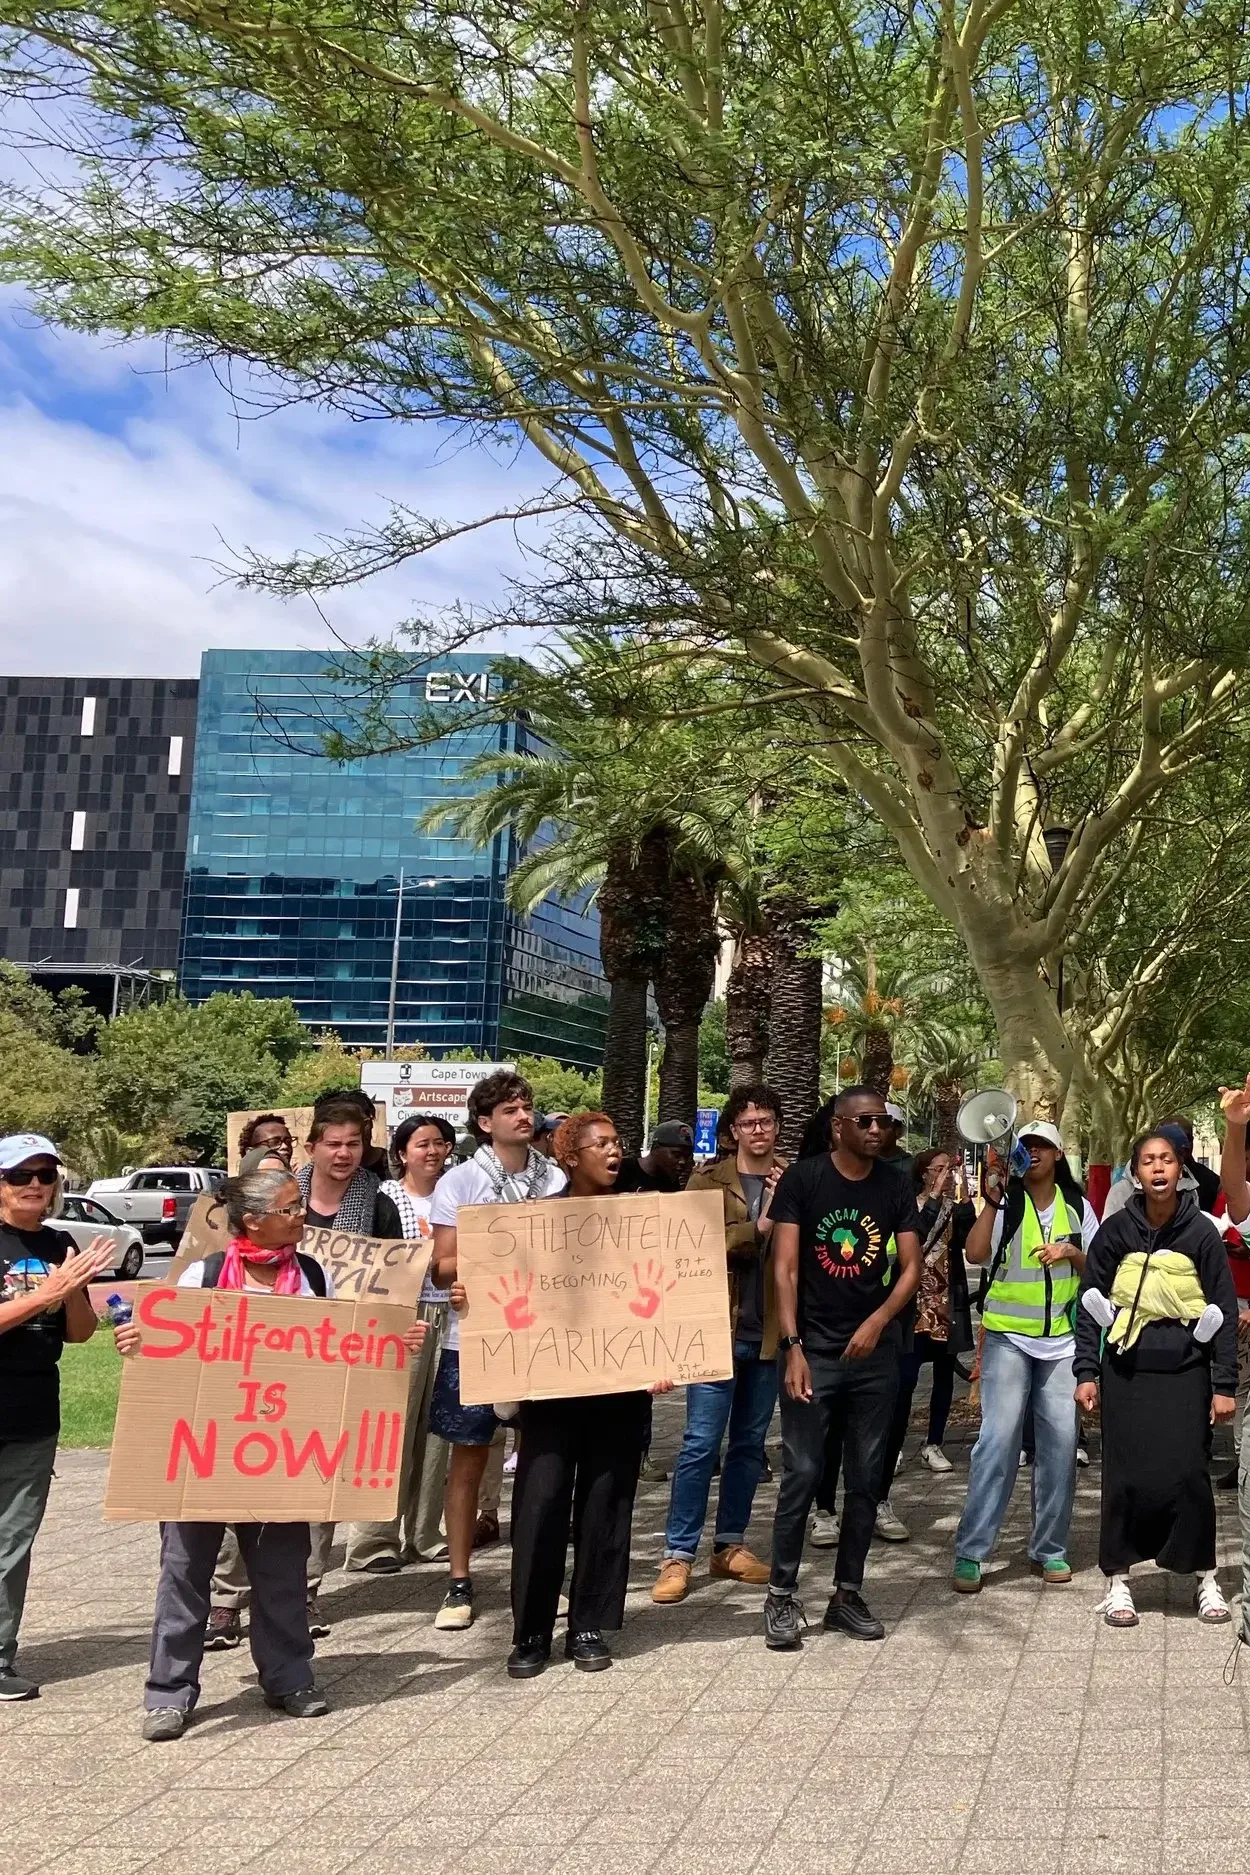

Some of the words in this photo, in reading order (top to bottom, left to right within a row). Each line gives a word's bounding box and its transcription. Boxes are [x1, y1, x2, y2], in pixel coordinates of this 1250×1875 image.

[431, 1068, 457, 1081] Cape
[460, 1068, 487, 1080] Town
[418, 1091, 467, 1104] Artscape
[487, 1212, 706, 1257] STILFONTEIN
[815, 1207, 859, 1241] AFRICAN
[860, 1215, 882, 1267] CLIMATE
[300, 1225, 424, 1267] PROTECT
[814, 1244, 860, 1279] ALLIANCE
[323, 1258, 390, 1296] TAL
[540, 1271, 627, 1292] BECOMING
[677, 1268, 713, 1279] KILLED
[139, 1288, 405, 1376] Stilfontein
[481, 1325, 706, 1376] MARIKANA
[233, 1381, 288, 1424] IS
[165, 1409, 401, 1489] NOW!!!
